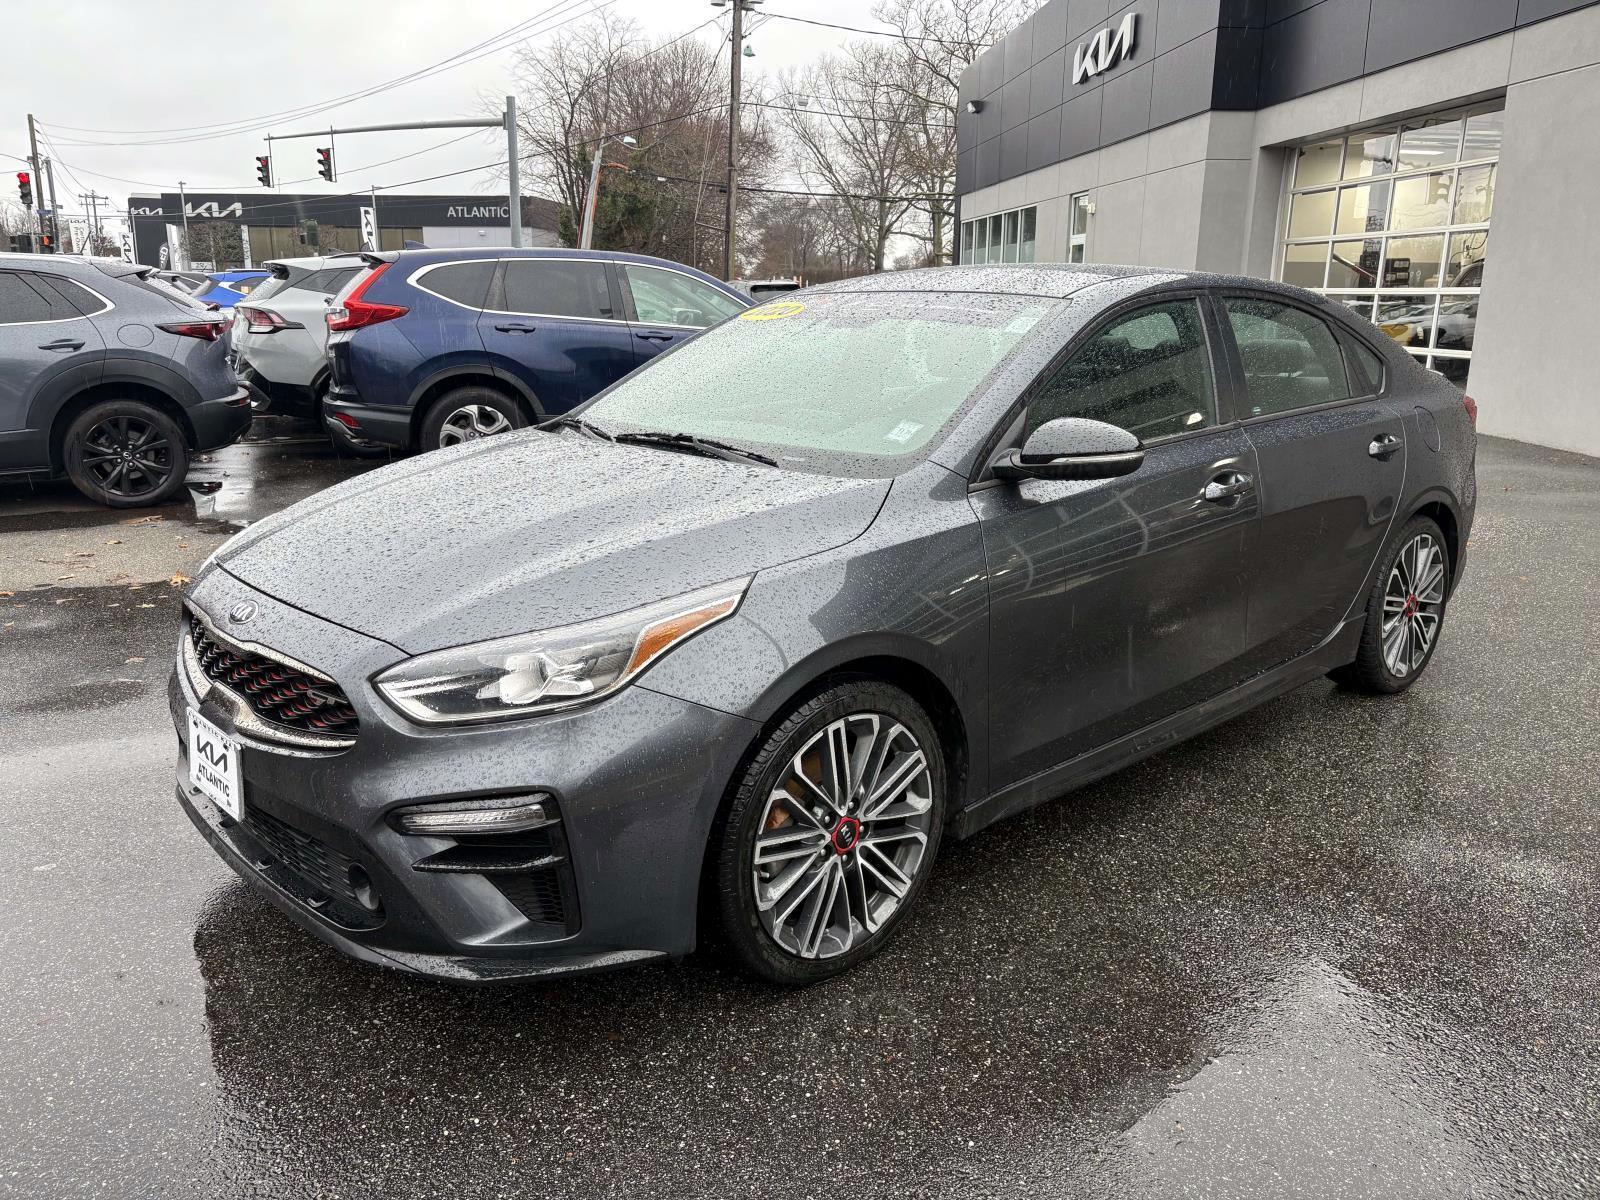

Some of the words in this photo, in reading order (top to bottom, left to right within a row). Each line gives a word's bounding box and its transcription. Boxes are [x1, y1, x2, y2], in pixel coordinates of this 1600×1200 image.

[1072, 13, 1135, 85] KIA
[185, 202, 242, 217] KIA
[447, 206, 509, 218] ATLANTIC
[196, 733, 229, 774] KIA
[198, 762, 230, 798] ATLANTIC
